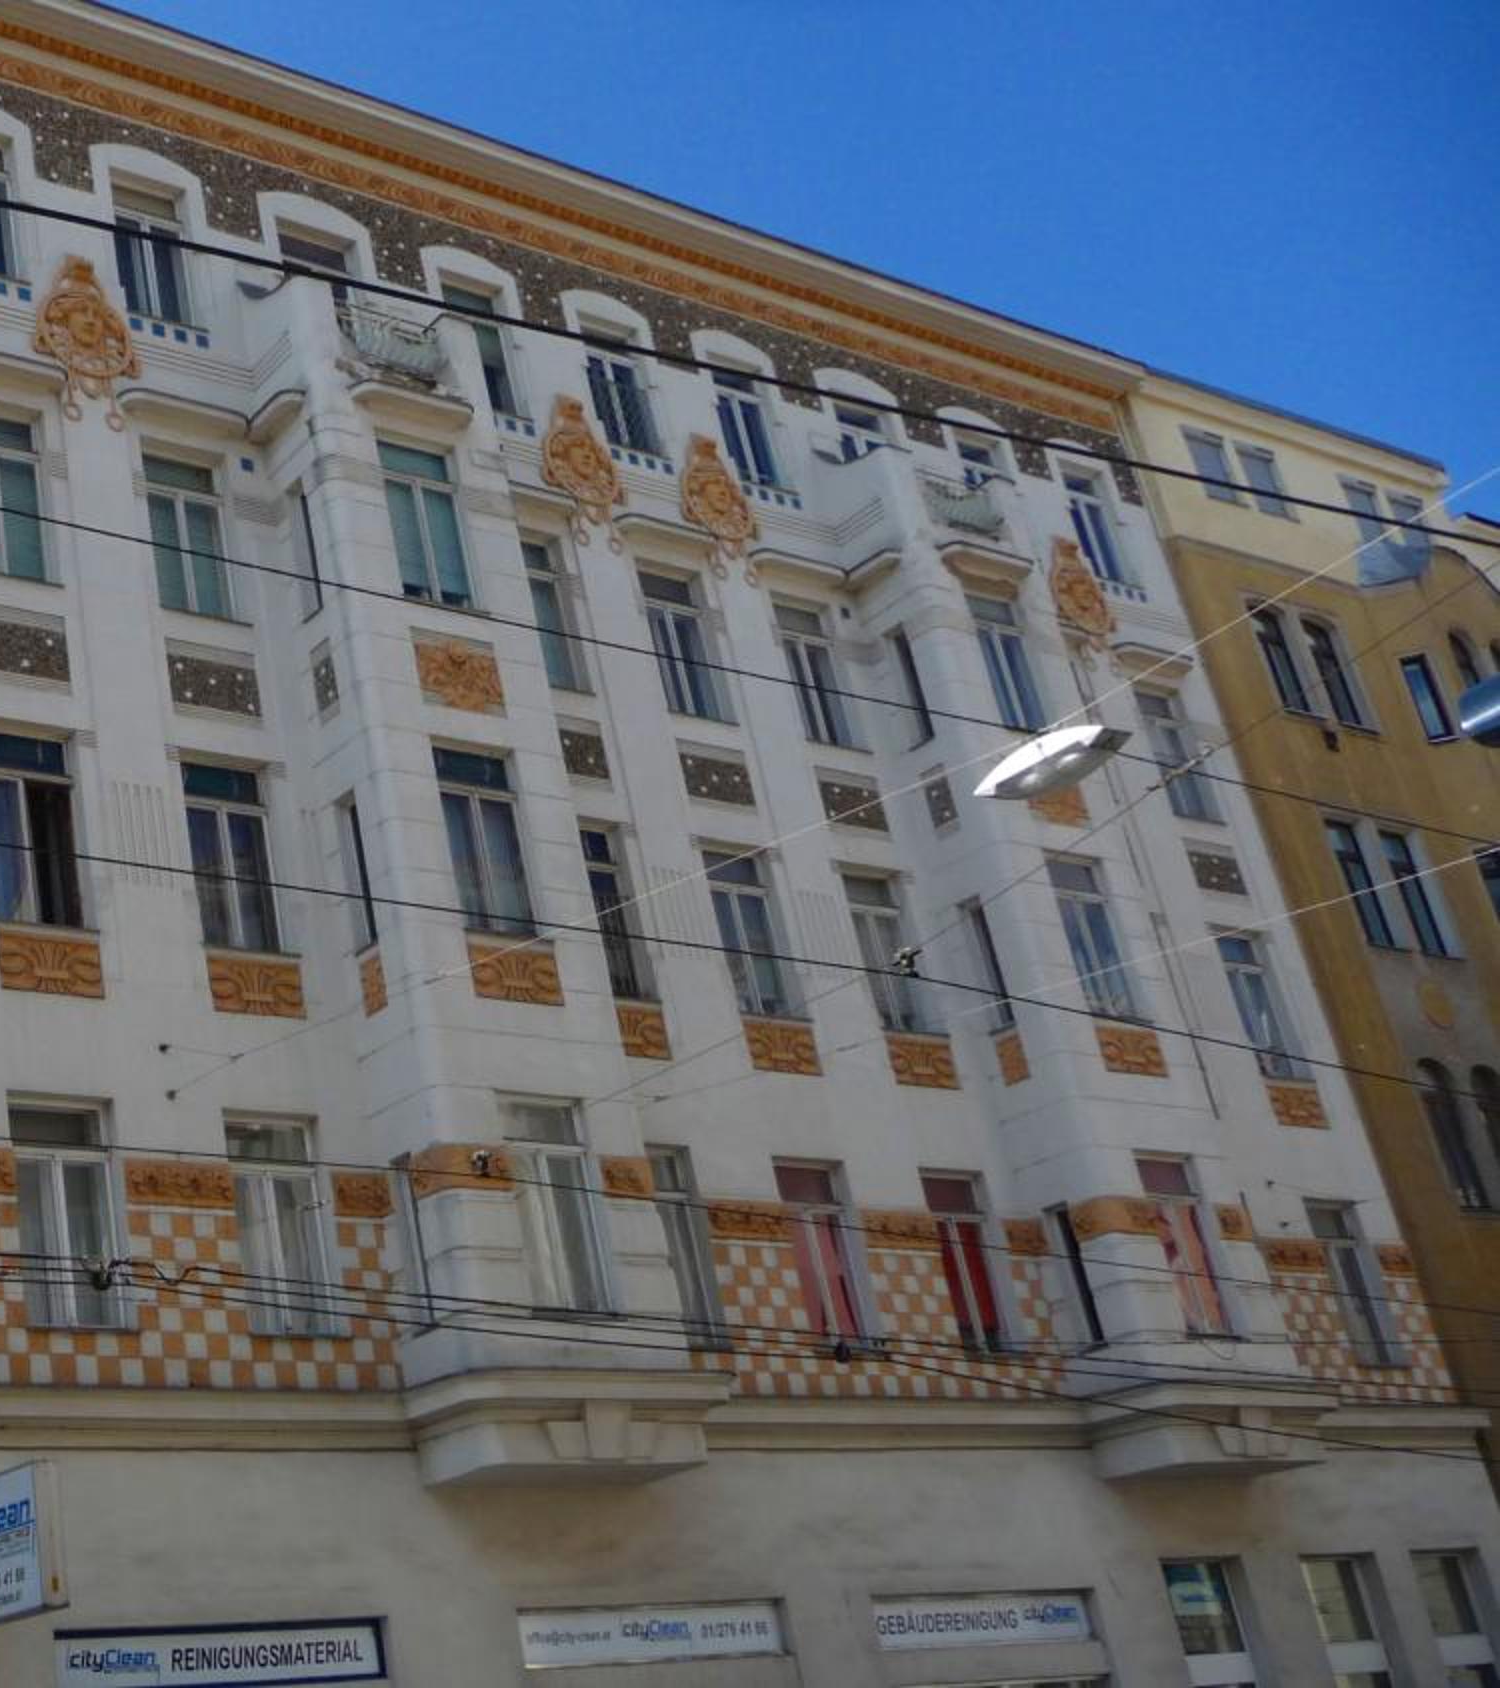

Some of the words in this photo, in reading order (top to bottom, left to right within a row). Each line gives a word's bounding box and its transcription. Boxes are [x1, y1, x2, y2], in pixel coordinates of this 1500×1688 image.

[876, 1610, 1018, 1635] GEBÄUDEREINIGUNG
[69, 1650, 156, 1673] cityClean
[171, 1639, 364, 1672] REINIGUNGSMATERIAL
